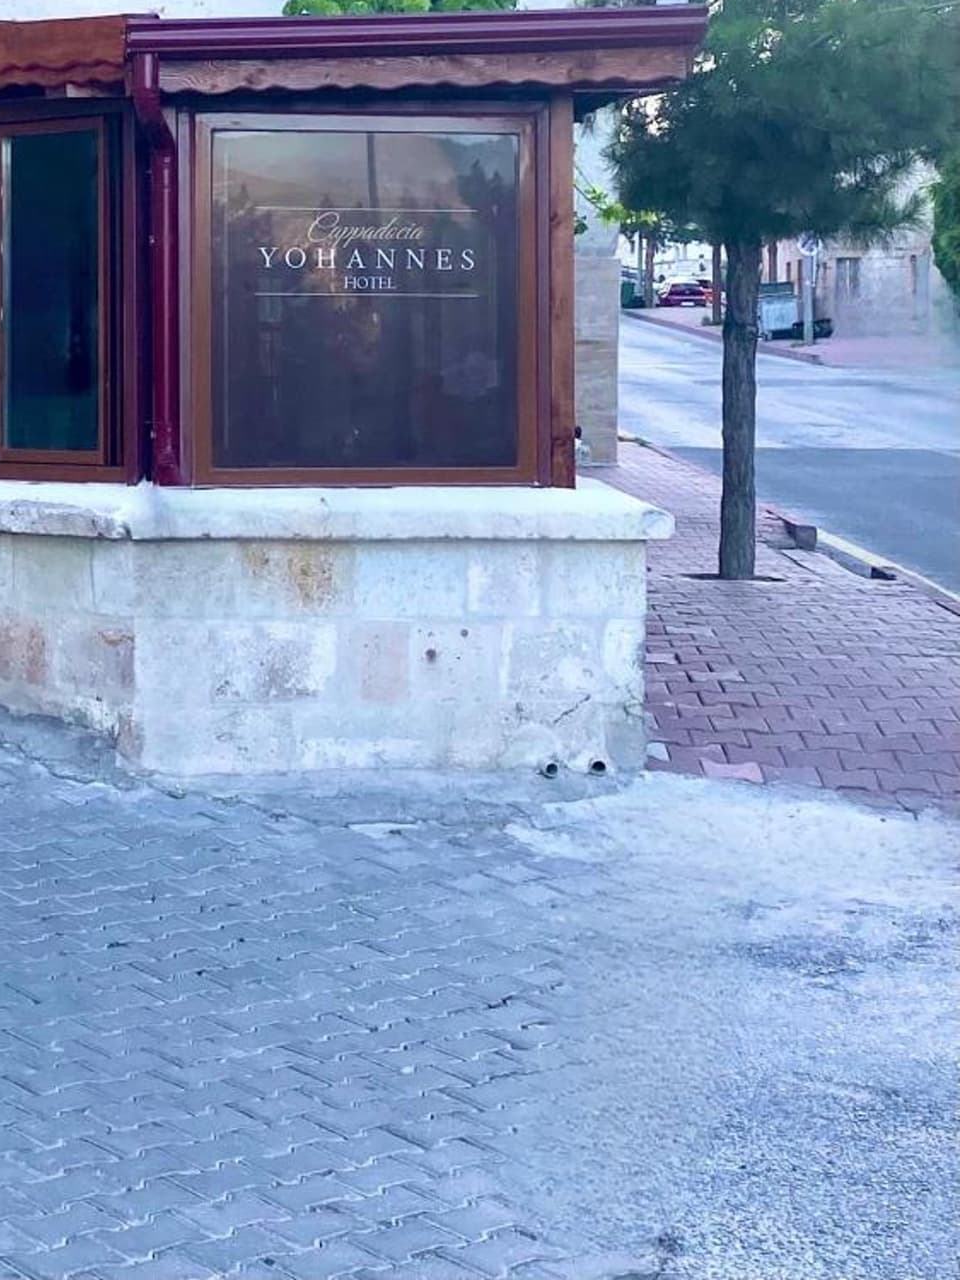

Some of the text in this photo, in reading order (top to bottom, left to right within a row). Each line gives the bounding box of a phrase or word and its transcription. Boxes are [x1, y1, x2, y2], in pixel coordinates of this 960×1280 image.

[308, 211, 424, 248] Cappadocia
[259, 247, 475, 270] YOHANNES
[344, 276, 395, 289] HOTEL
